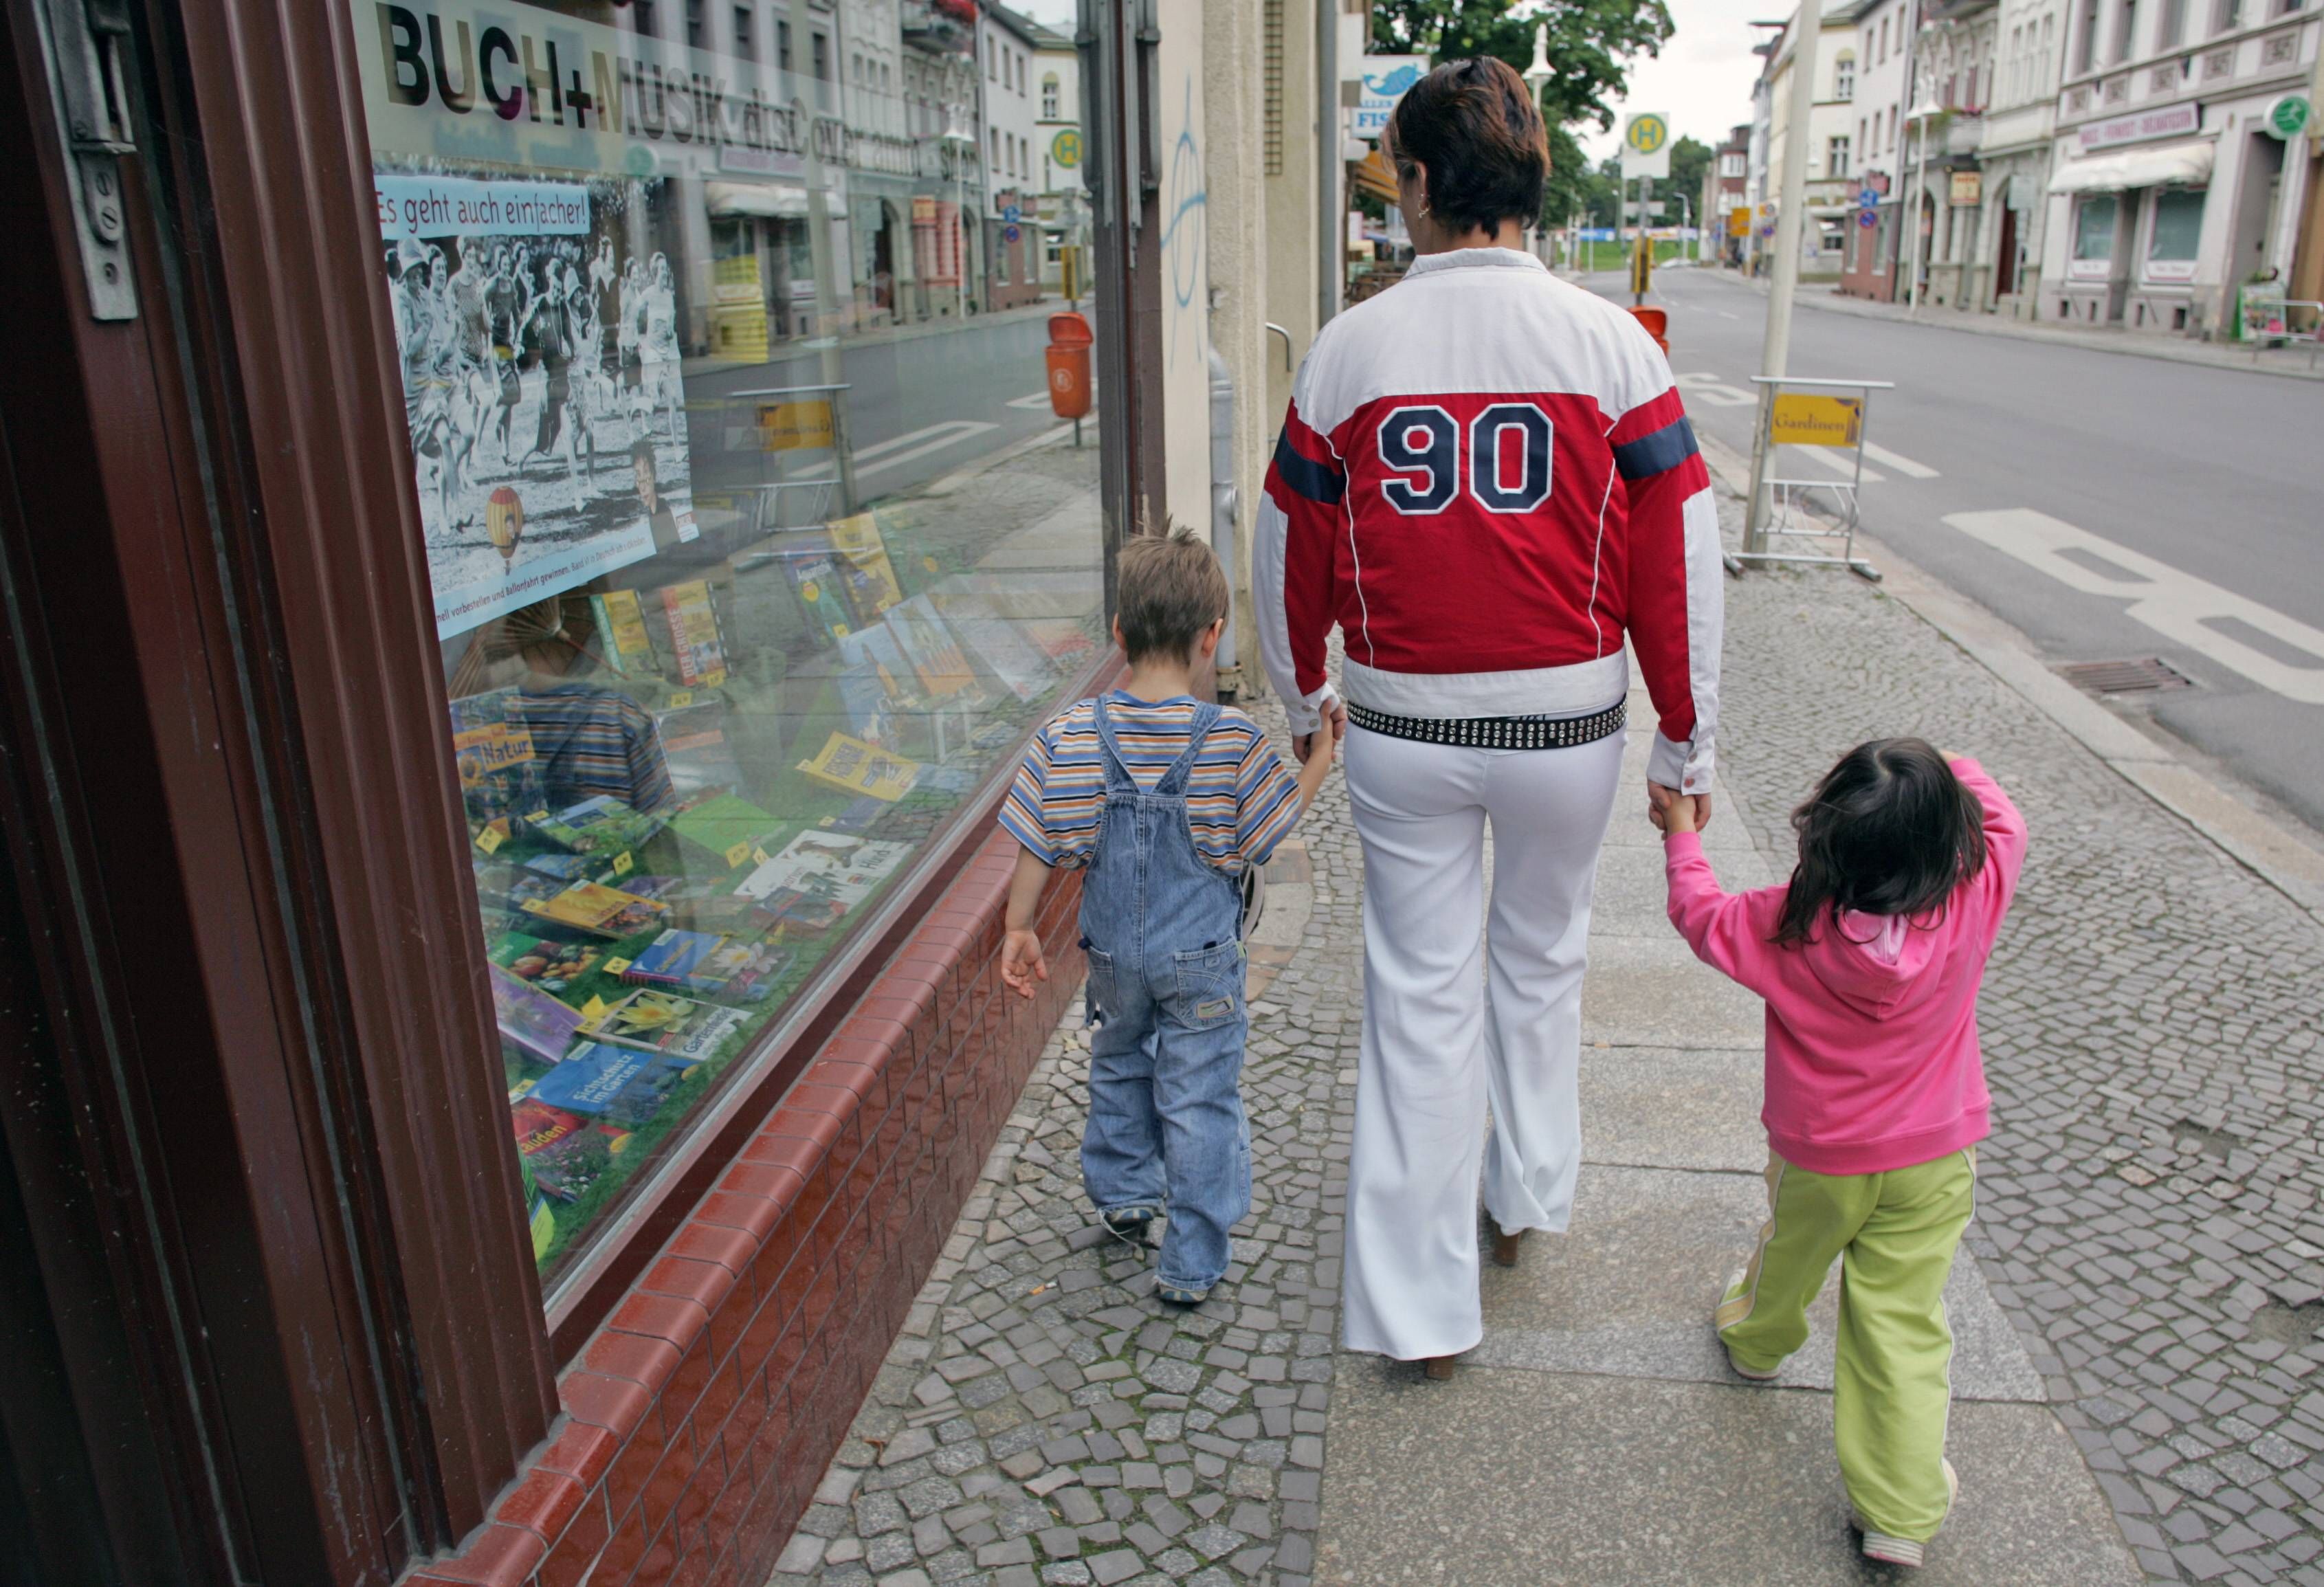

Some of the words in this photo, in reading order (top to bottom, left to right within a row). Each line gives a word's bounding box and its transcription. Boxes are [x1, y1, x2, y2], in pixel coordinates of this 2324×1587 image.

[375, 191, 397, 223] Es
[404, 188, 451, 234] geht
[458, 190, 500, 224] auch
[506, 192, 588, 232] einfacher!
[1775, 413, 1845, 431] Gardinen
[1377, 402, 1553, 515] 90
[451, 595, 491, 616] vorbestellen
[492, 586, 506, 602] und
[668, 608, 689, 654] GROSSE
[680, 655, 695, 678] DER
[483, 740, 529, 766] Natur
[859, 849, 892, 869] Hund
[572, 1054, 634, 1102] Sichtschutz
[589, 1091, 606, 1104] im
[604, 1063, 641, 1093] Garten
